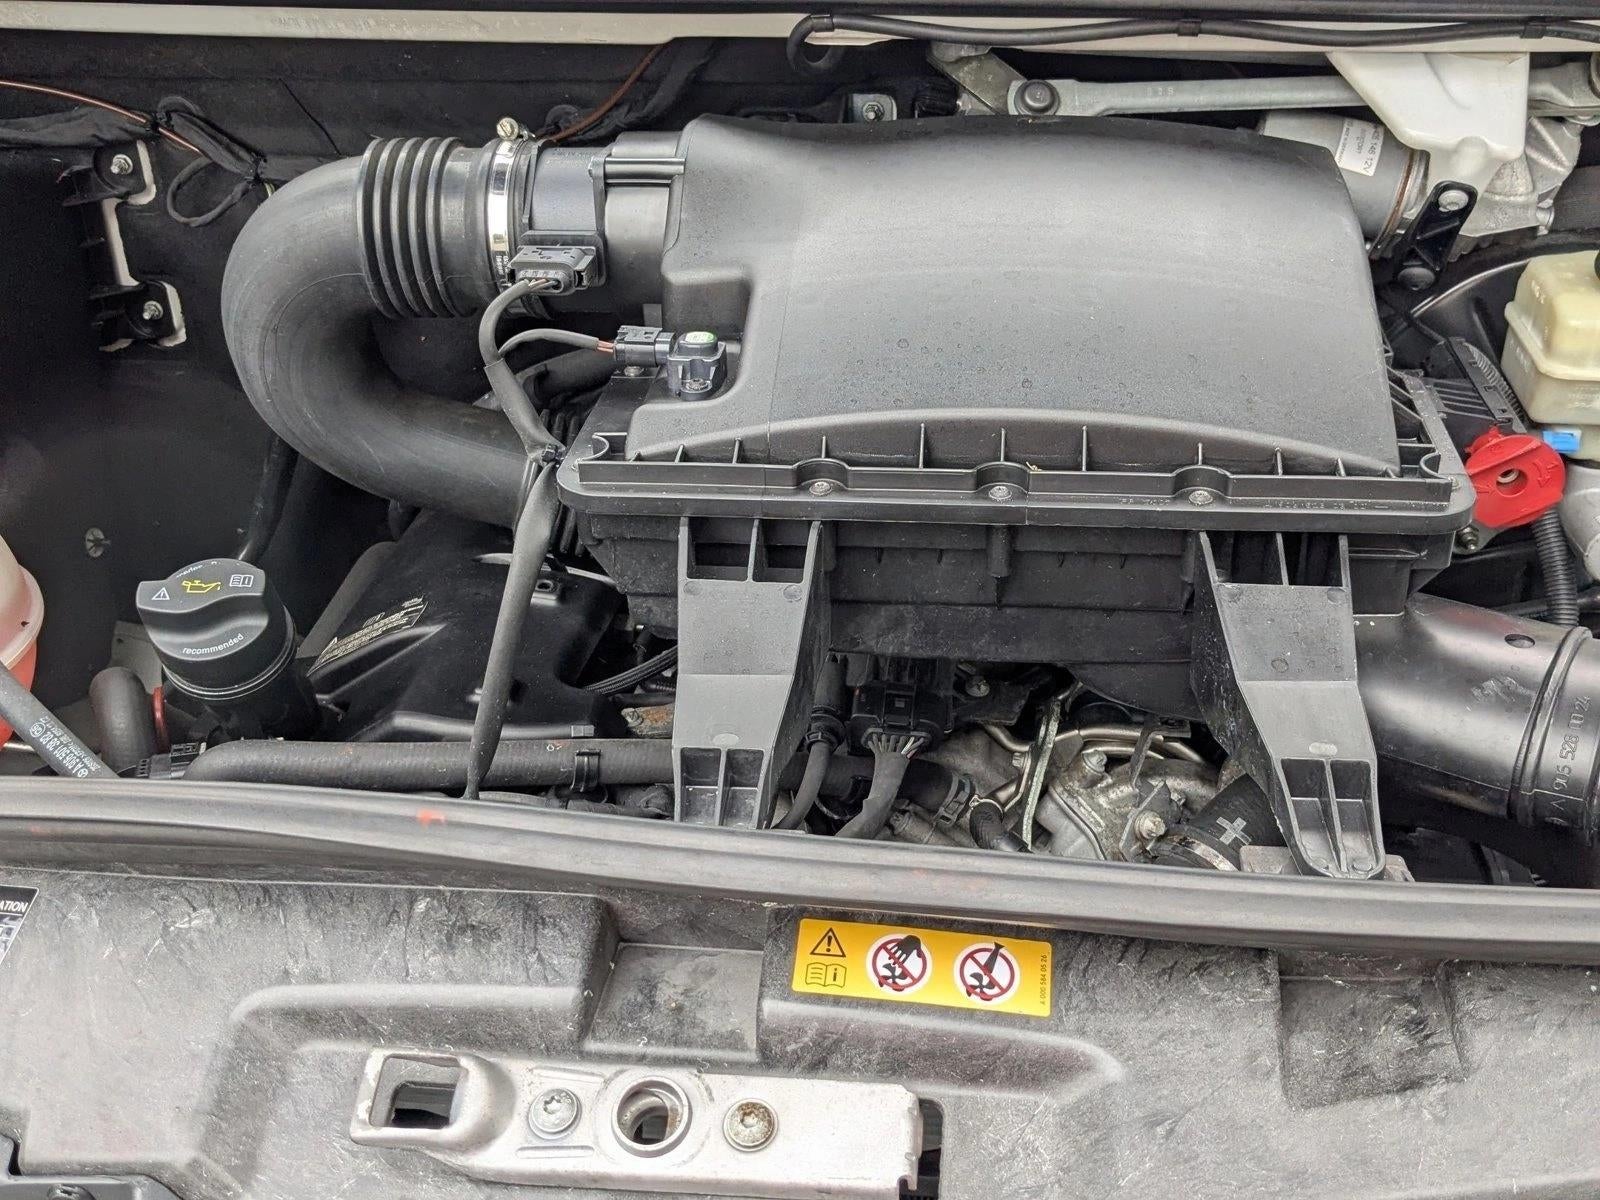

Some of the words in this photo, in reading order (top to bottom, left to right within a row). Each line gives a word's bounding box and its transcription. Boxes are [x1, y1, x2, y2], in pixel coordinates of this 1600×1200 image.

[182, 633, 244, 655] recommended
[53, 745, 71, 761] 501
[1558, 733, 1580, 761] 528
[63, 752, 77, 770] 906
